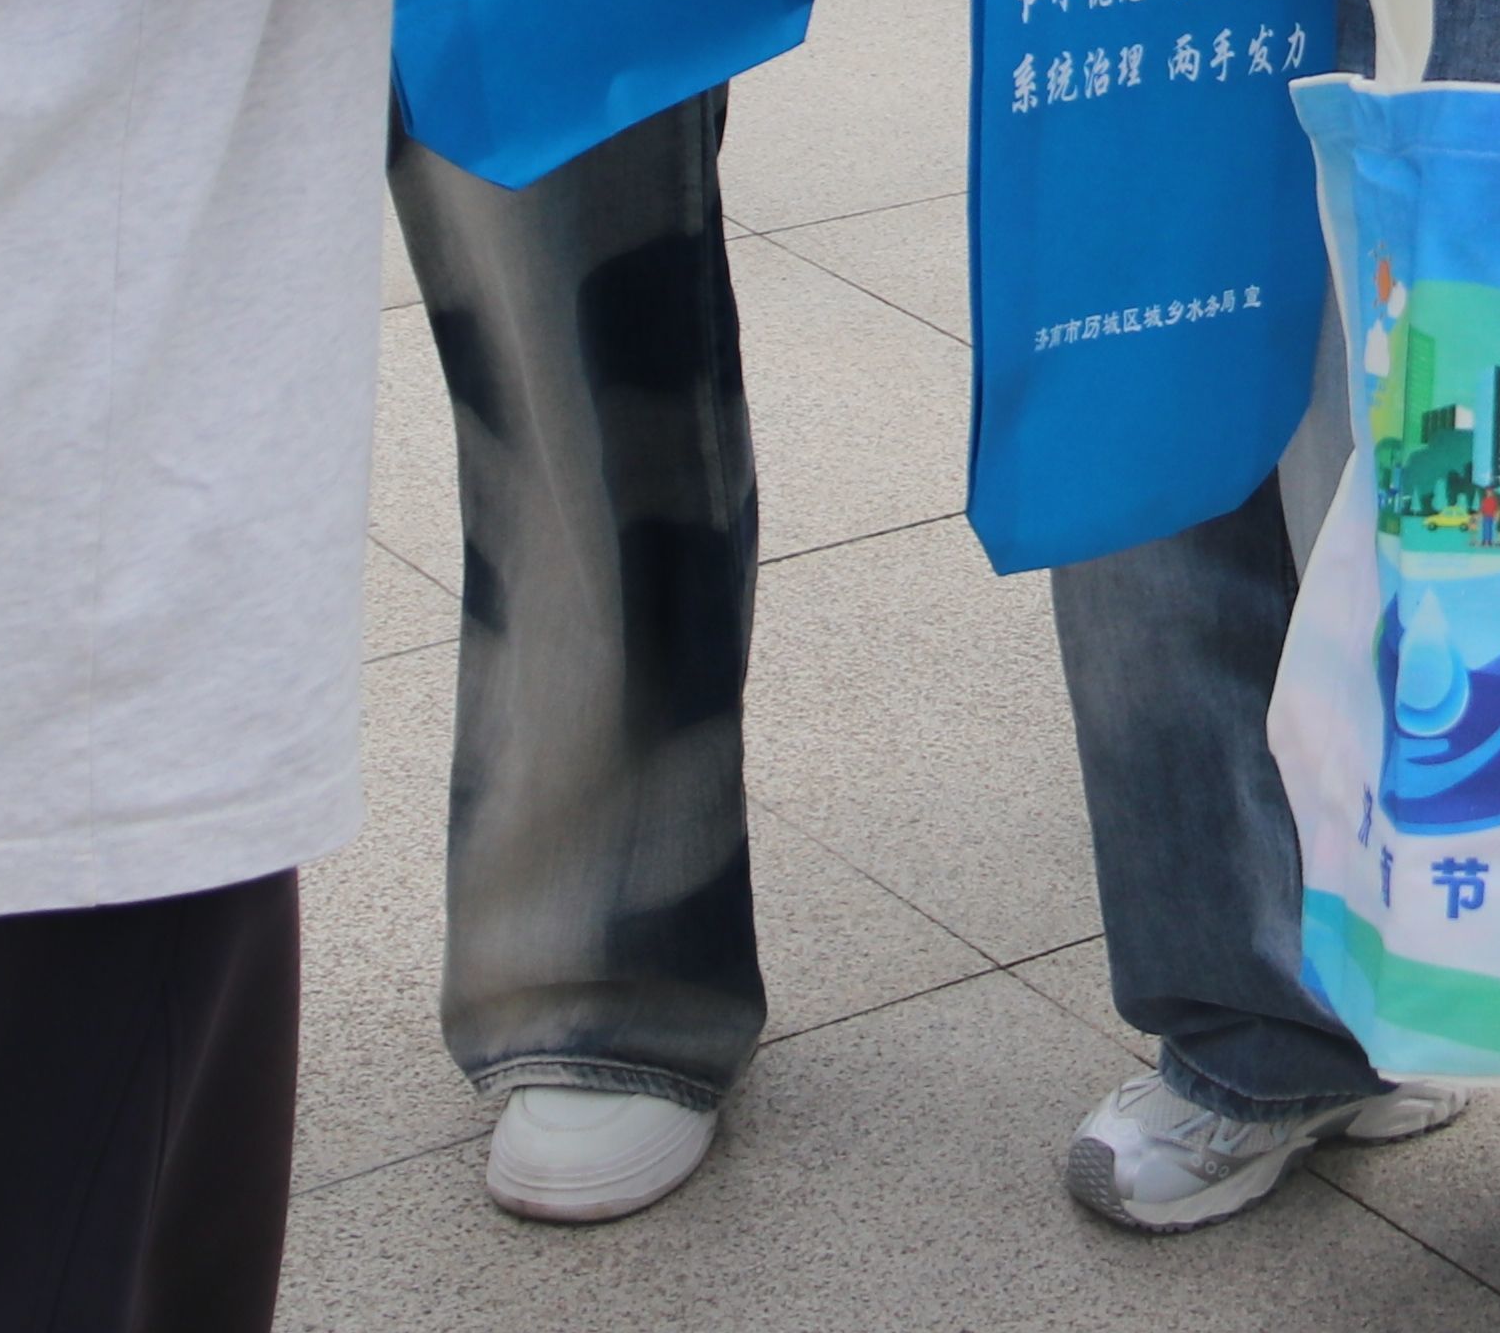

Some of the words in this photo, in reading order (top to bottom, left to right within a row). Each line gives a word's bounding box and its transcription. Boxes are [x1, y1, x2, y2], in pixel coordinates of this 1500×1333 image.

[1012, 43, 1144, 113] 系统治理
[1167, 23, 1306, 82] 两手发力
